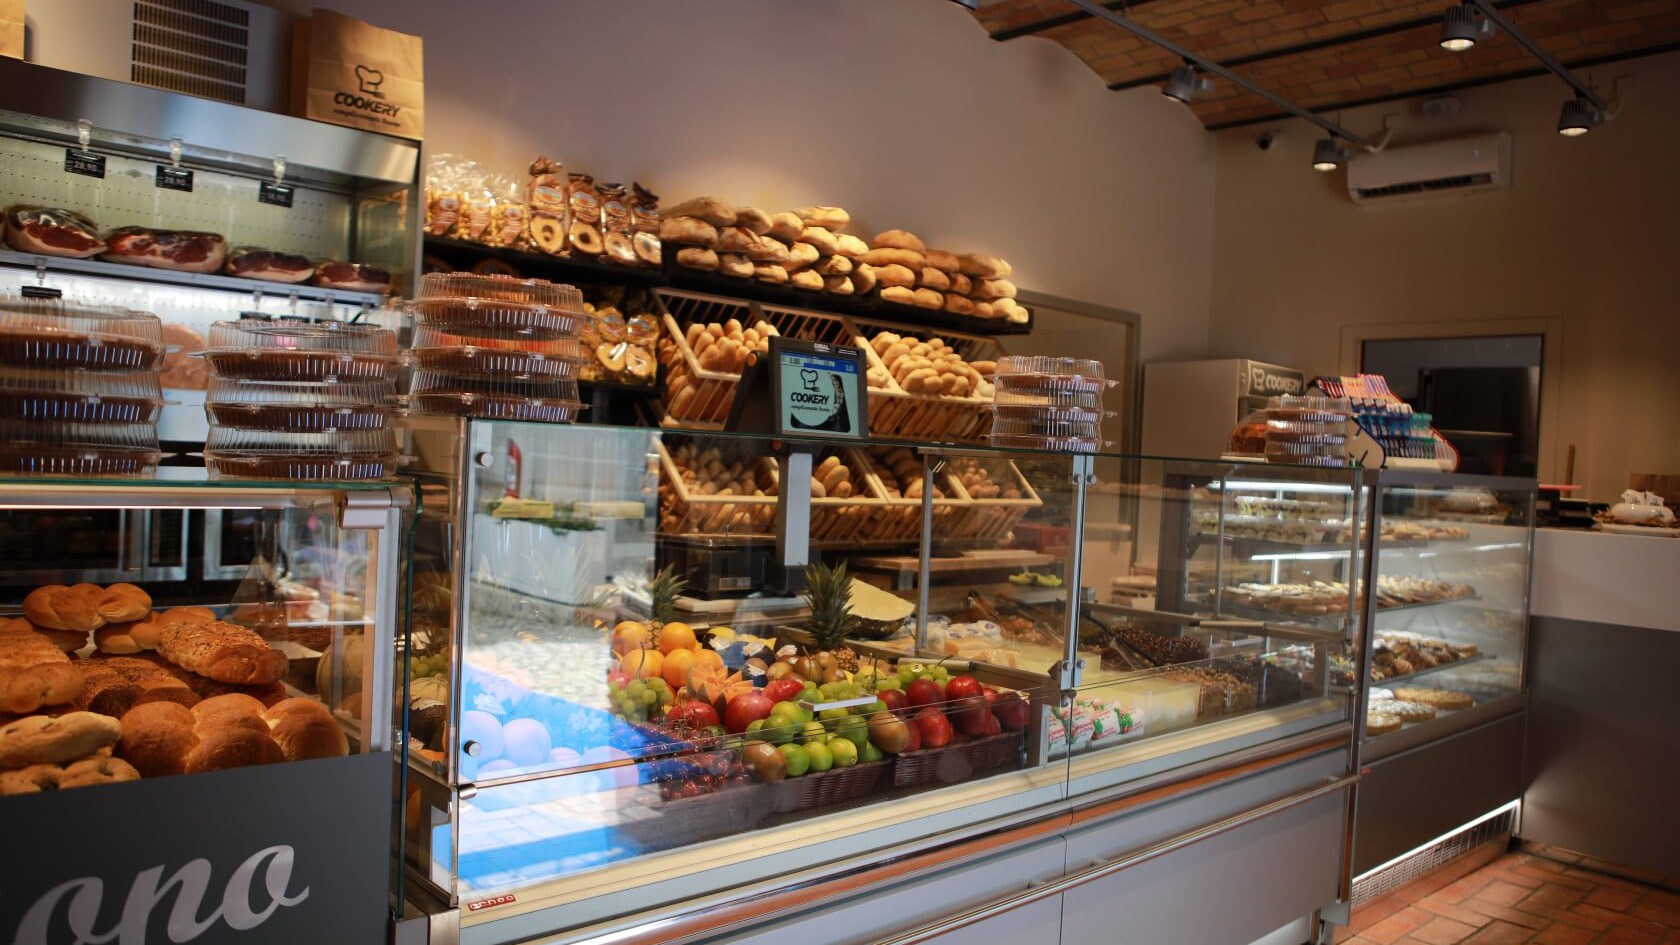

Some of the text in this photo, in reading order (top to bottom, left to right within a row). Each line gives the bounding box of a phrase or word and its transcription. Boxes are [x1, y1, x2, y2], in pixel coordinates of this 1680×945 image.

[334, 91, 400, 117] COOKERY
[1266, 374, 1300, 394] COOKERY
[790, 391, 830, 405] COOKERY
